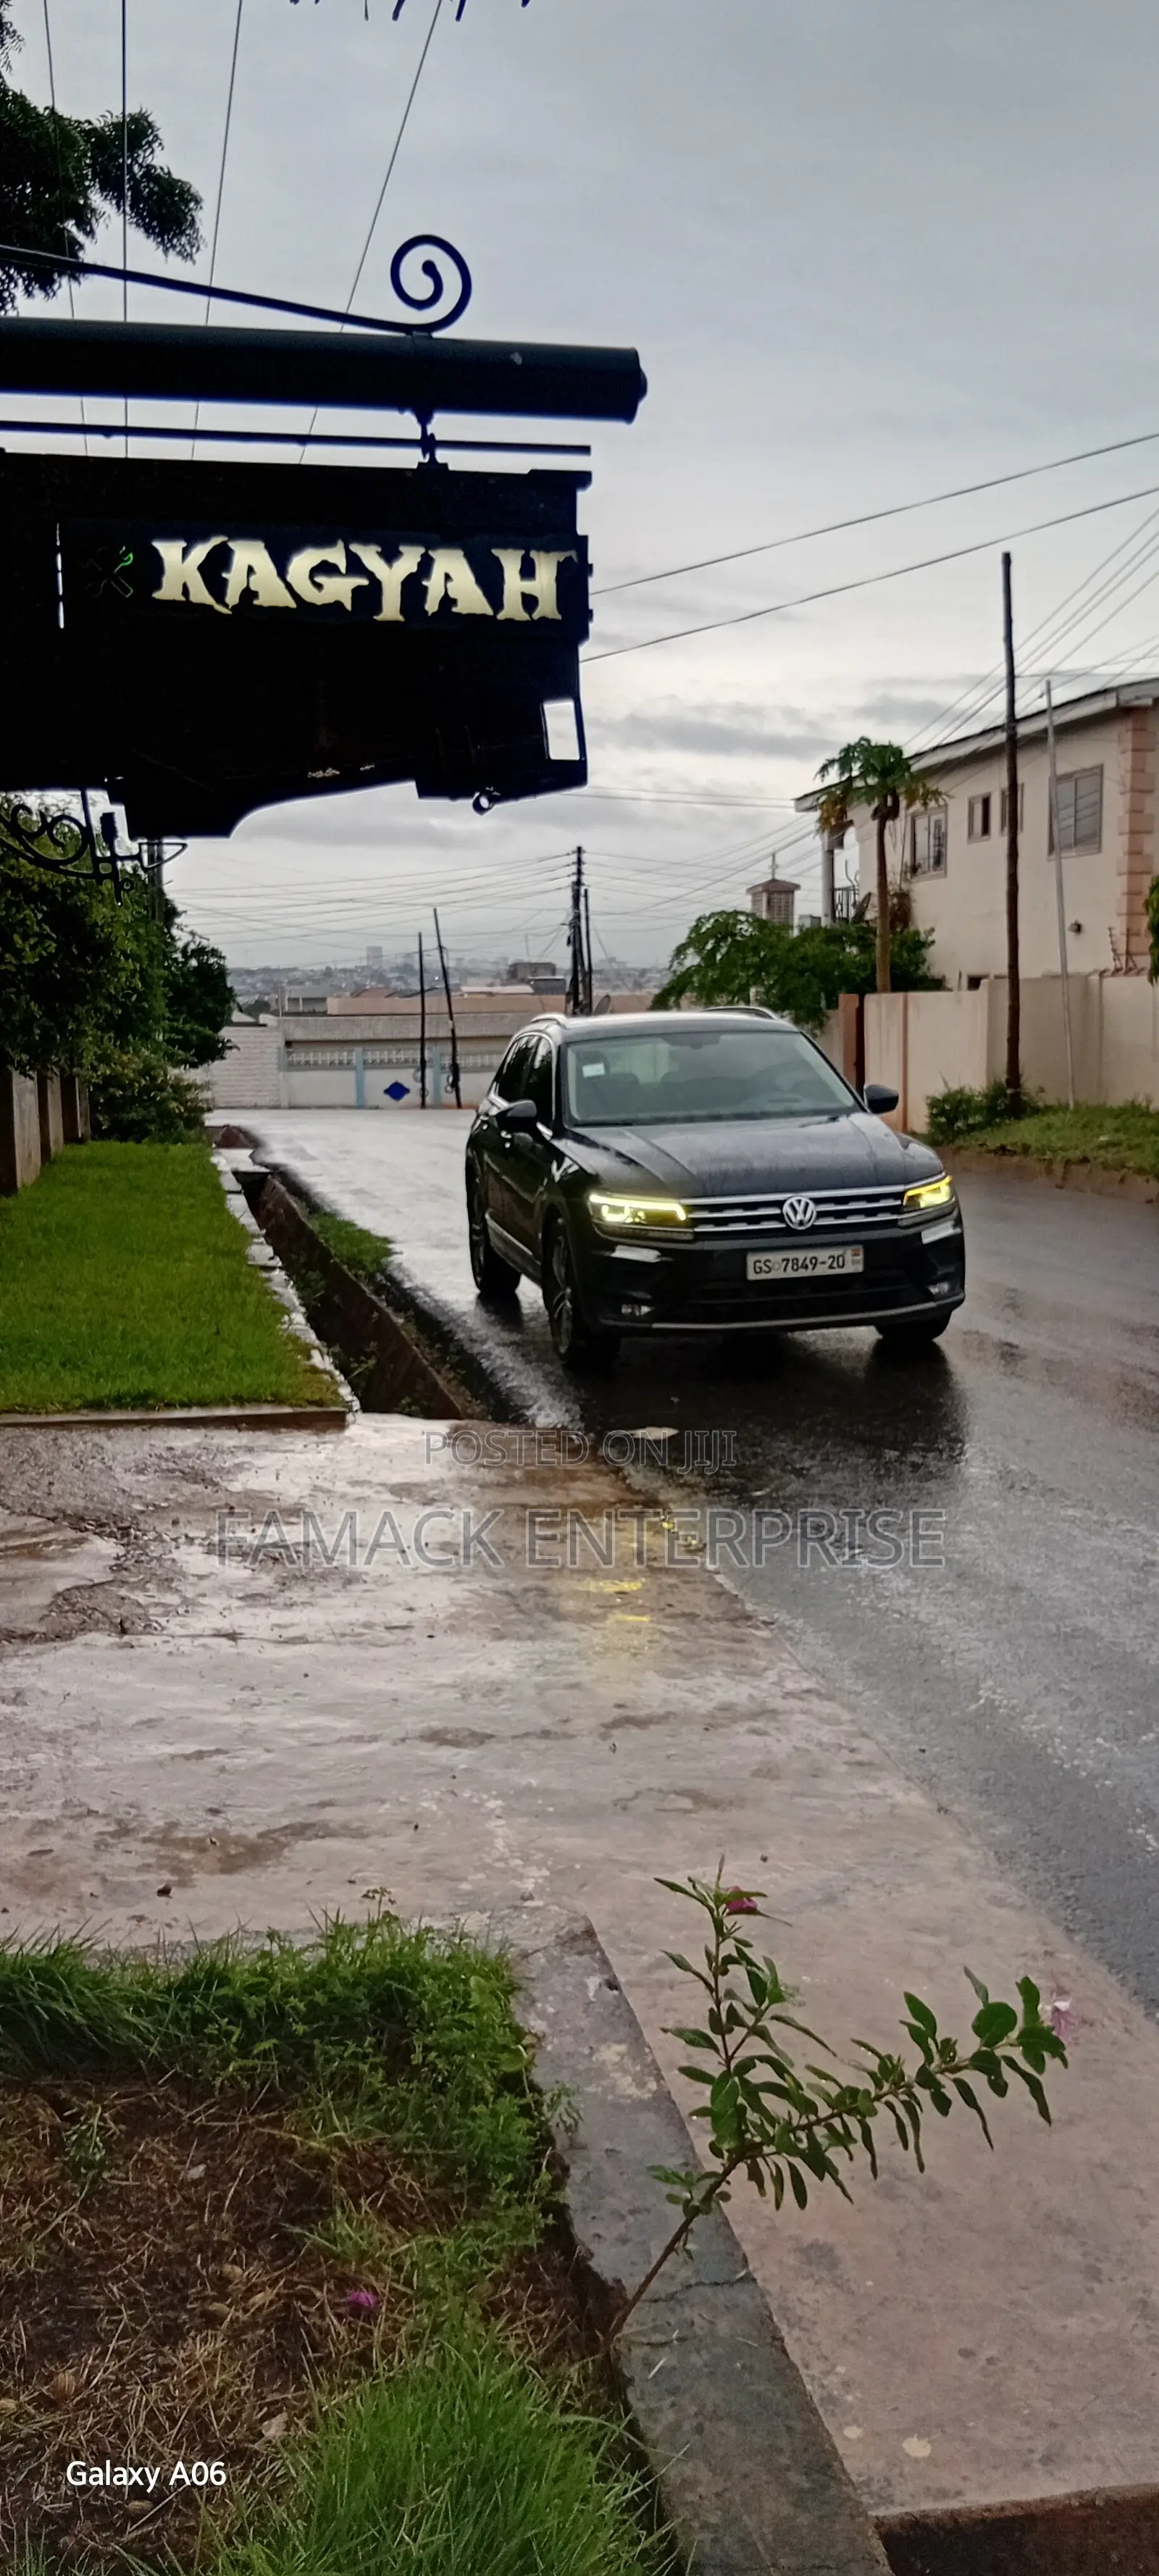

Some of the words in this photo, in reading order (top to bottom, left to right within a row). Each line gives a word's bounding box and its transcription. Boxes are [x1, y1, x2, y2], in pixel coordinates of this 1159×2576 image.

[152, 535, 577, 622] KAGYAH
[753, 1259, 773, 1275] GS
[781, 1254, 846, 1274] 7849-20
